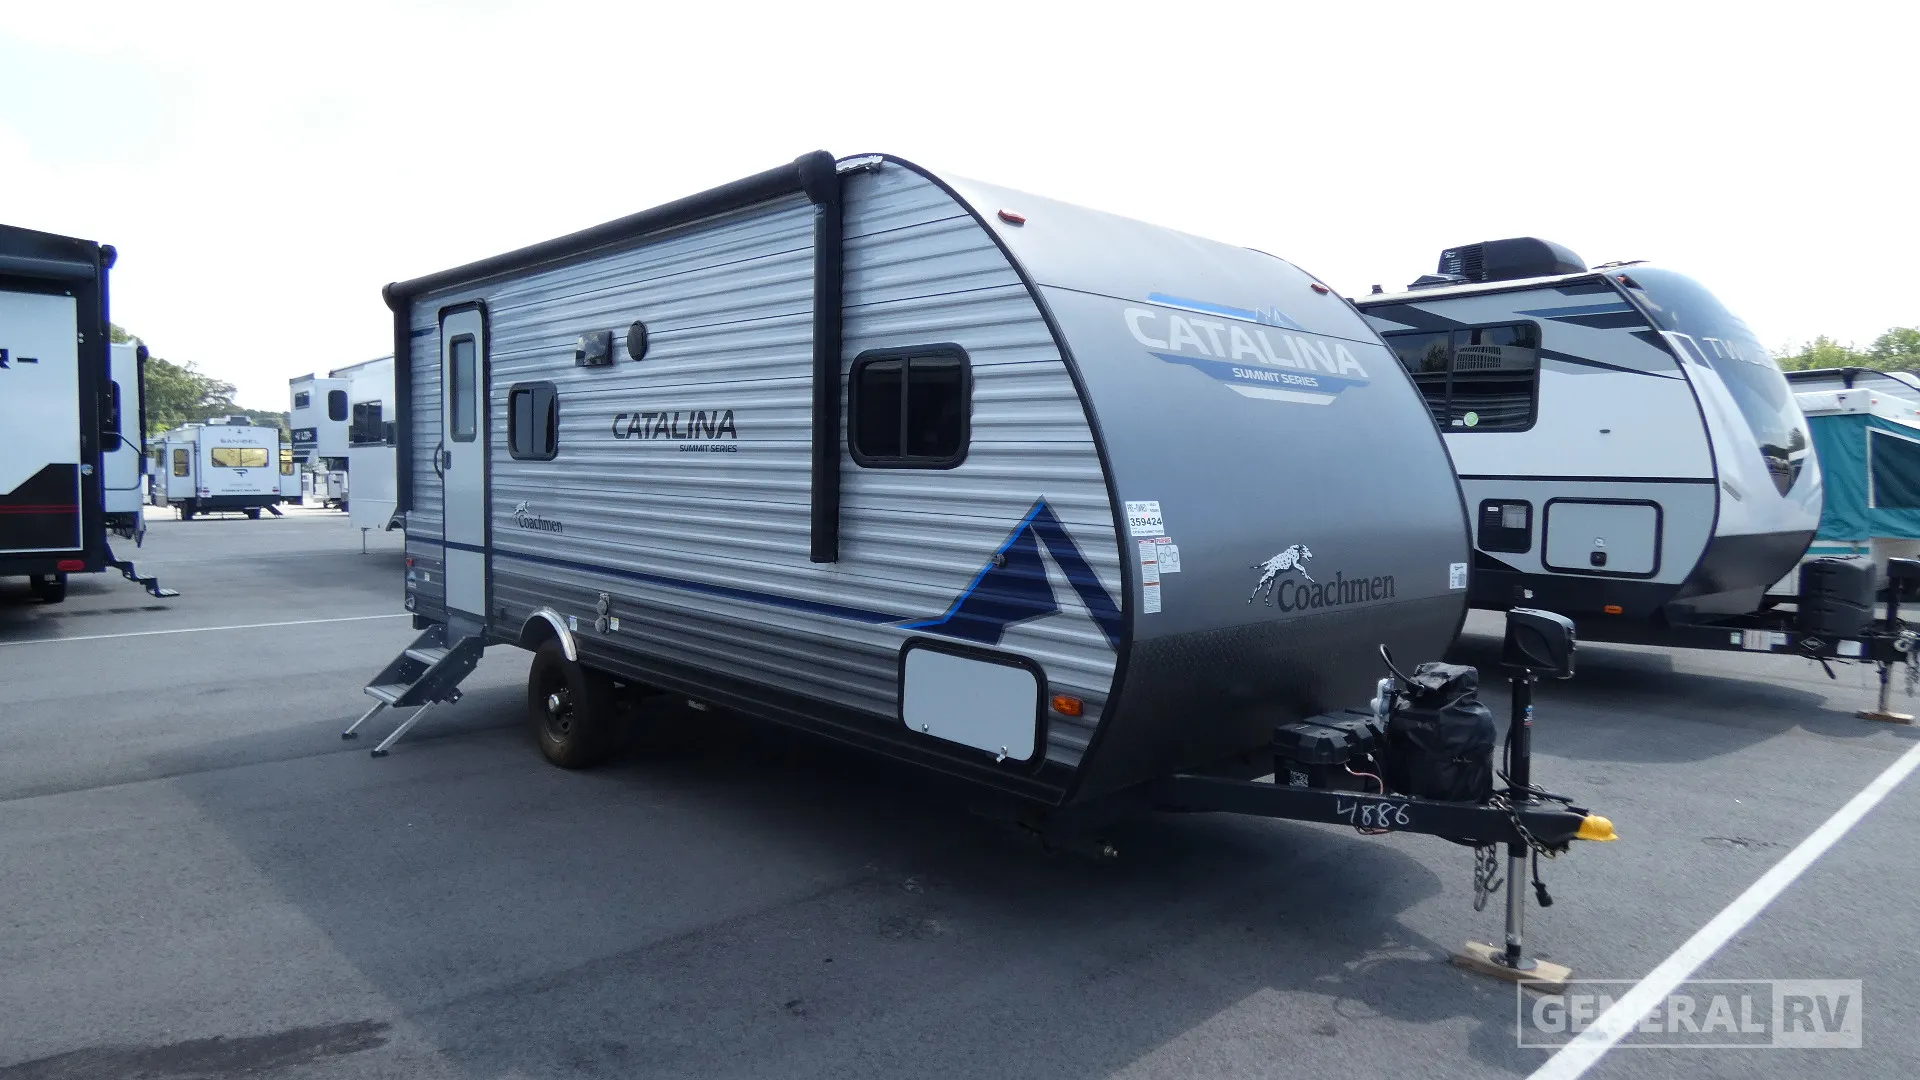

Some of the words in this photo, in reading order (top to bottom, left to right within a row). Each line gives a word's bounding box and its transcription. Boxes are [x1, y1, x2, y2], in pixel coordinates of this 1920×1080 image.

[1123, 307, 1369, 378] CATALINA
[1231, 367, 1281, 383] SUMMIT
[1280, 372, 1319, 388] SERIES
[611, 409, 738, 440] CATALINA
[679, 444, 710, 453] SUMMIT
[710, 444, 738, 453] SERIES
[518, 514, 563, 533] Coachmen
[1129, 517, 1163, 527] 359424
[1277, 570, 1396, 613] Coachmen
[1337, 799, 1410, 828] 4886
